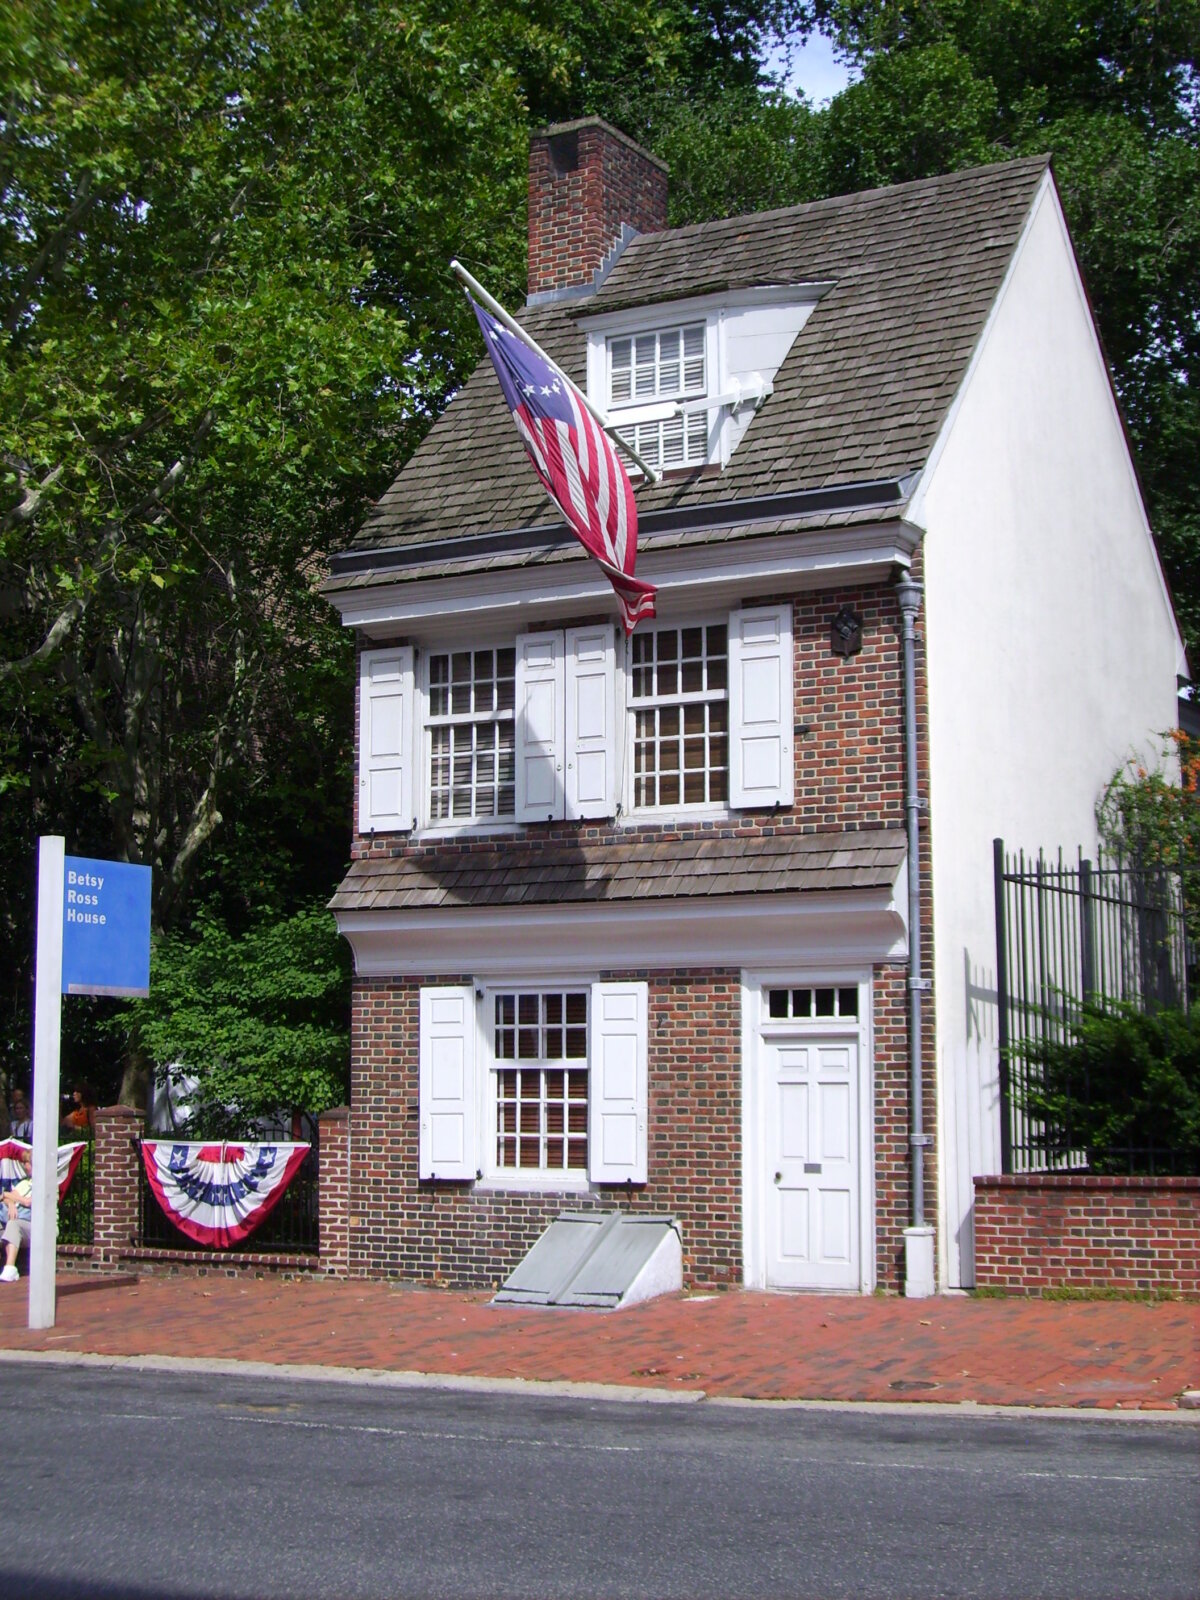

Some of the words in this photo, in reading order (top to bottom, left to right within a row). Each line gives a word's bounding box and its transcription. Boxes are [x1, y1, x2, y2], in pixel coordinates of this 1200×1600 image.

[68, 871, 104, 890] Betsy
[67, 890, 98, 905] Ross
[67, 908, 107, 925] House
